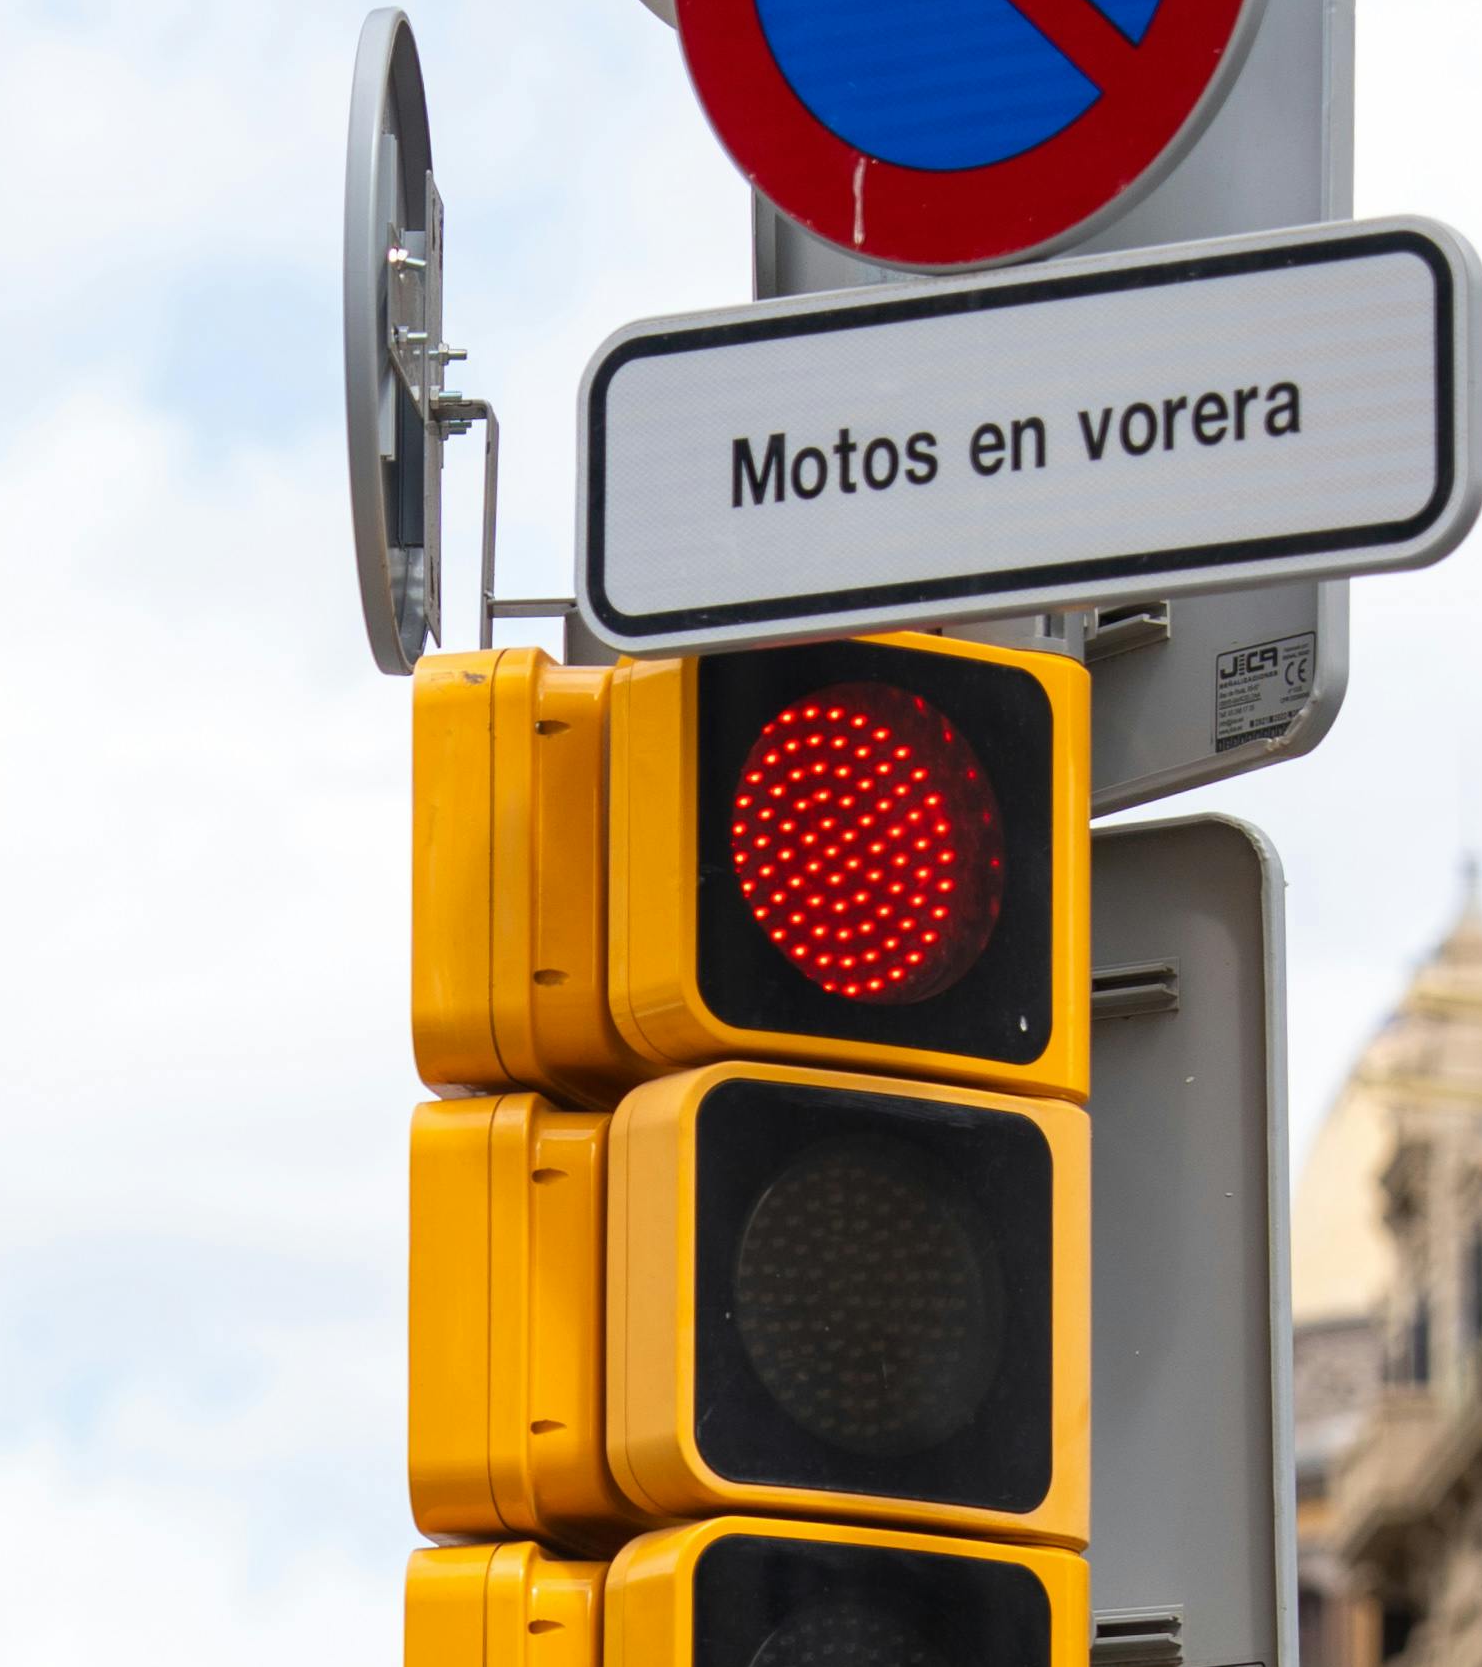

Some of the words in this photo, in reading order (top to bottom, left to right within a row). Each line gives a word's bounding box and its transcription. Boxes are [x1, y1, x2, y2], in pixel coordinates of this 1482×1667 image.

[730, 430, 938, 509] Motos
[969, 416, 1046, 478] en
[1076, 380, 1301, 462] vorera
